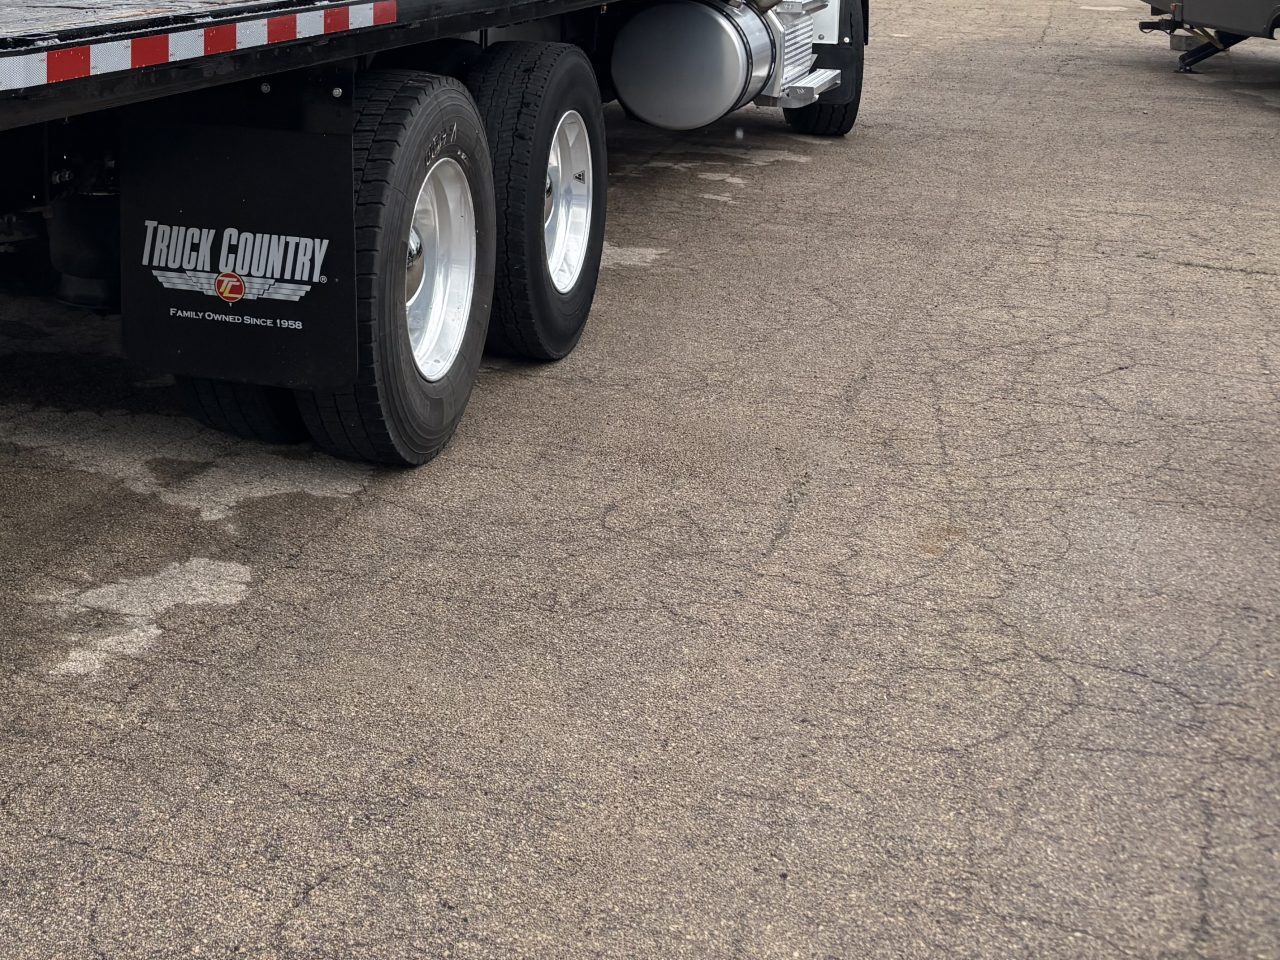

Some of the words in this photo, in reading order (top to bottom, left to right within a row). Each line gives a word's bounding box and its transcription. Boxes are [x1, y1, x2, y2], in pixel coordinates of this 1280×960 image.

[141, 220, 217, 271] TRUCK
[218, 227, 330, 283] COUNTRY
[169, 307, 204, 320] FAMILY
[205, 311, 242, 323] OWNED
[243, 315, 274, 327] SINCE
[276, 318, 303, 330] 1958
